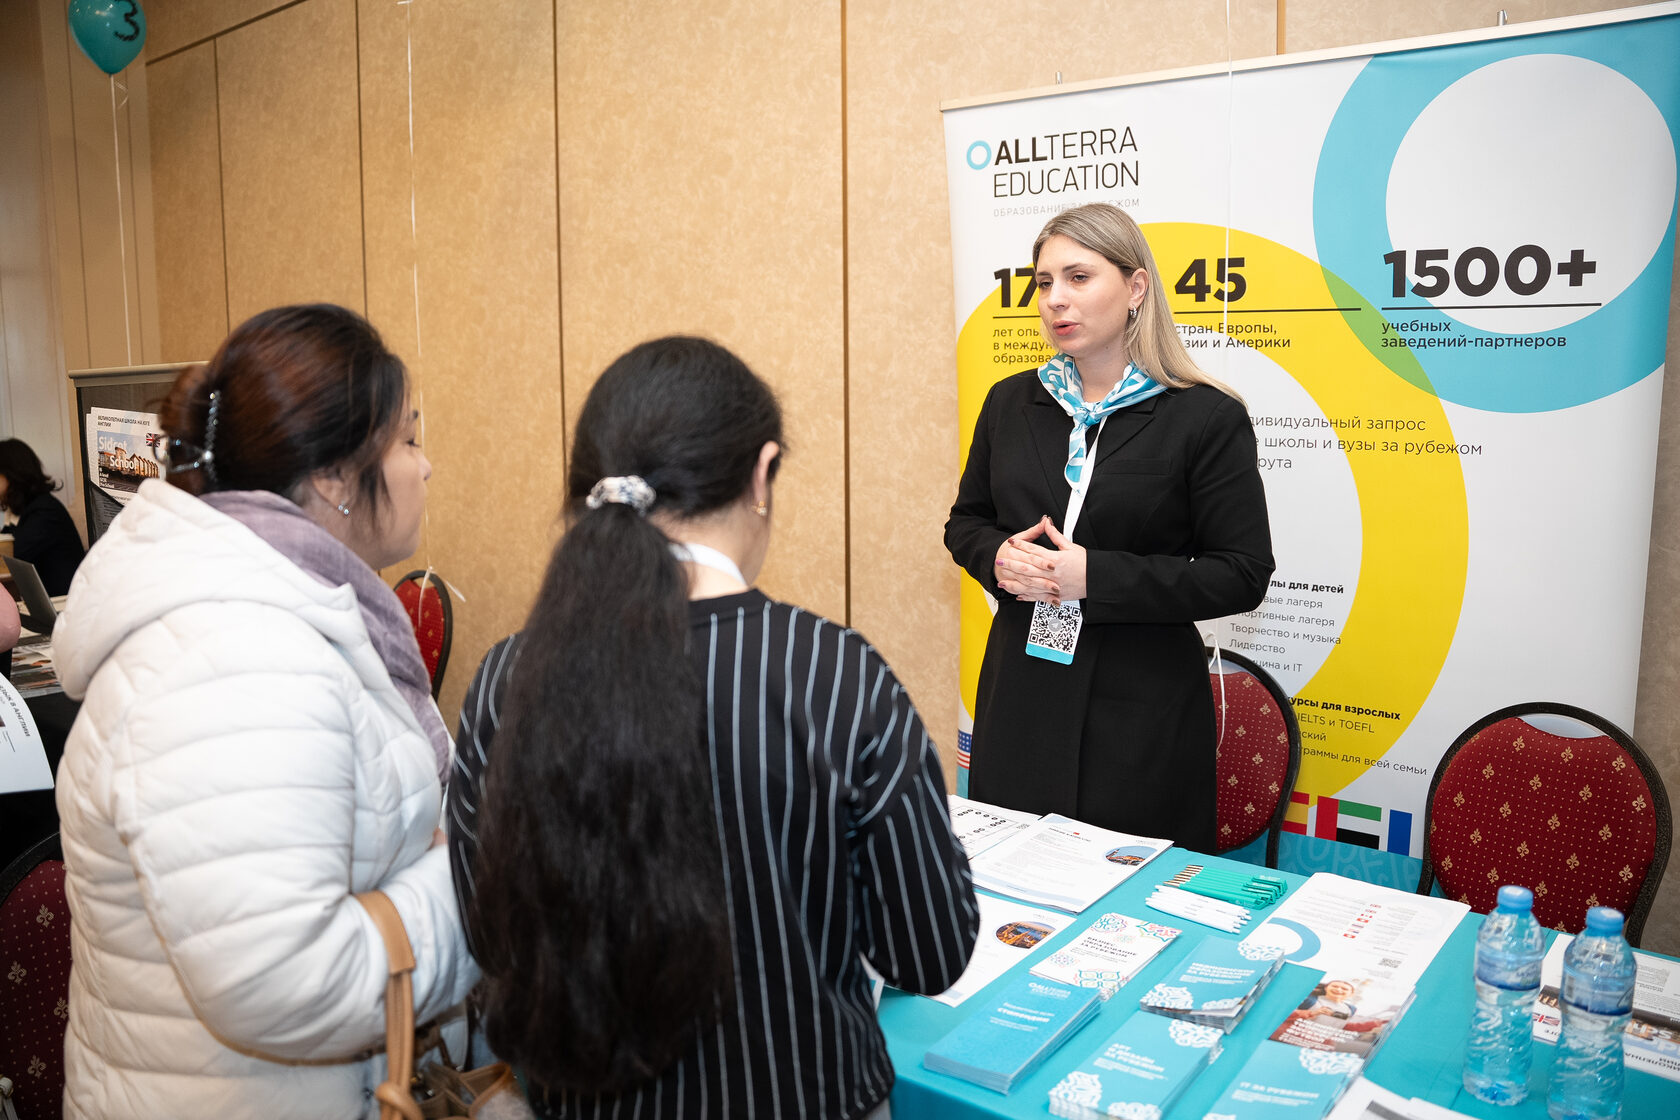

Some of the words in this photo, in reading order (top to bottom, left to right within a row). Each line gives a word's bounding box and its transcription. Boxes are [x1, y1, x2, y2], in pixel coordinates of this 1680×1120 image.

[994, 126, 1138, 166] ALLTERRA
[993, 160, 1140, 198] EDUCATION
[1383, 244, 1597, 298] 1500+
[1174, 257, 1247, 302] 45
[993, 329, 1013, 337] лет
[1218, 322, 1277, 335] Европы,
[1381, 320, 1451, 334] учебных
[993, 342, 1000, 350] в
[1004, 341, 1053, 351] междун
[1184, 339, 1208, 348] зии
[1213, 339, 1221, 348] и
[1226, 337, 1291, 350] Америки
[1381, 334, 1567, 349] заведений-партнеров
[993, 353, 1053, 365] образова
[1249, 416, 1361, 430] дивидуальный
[1366, 418, 1427, 432] запрос
[1264, 437, 1318, 449] школы
[1323, 439, 1332, 449] и
[1338, 440, 1376, 452] вузы
[1382, 441, 1399, 452] за
[1404, 440, 1483, 456] рубежом
[1258, 457, 1292, 469] рута
[1270, 580, 1286, 588] лы
[1288, 582, 1309, 591] для
[1311, 584, 1344, 594] детей
[1263, 596, 1284, 604] вые
[1286, 598, 1323, 609] лагеря
[1234, 610, 1295, 622] портивные
[1298, 615, 1335, 627] лагеря
[1230, 623, 1290, 639] Творчество
[1302, 633, 1342, 645] музыка
[1229, 639, 1286, 654] Лидерство
[1293, 663, 1303, 672] IT
[1321, 701, 1342, 711] для
[1344, 705, 1401, 720] взрослых
[1297, 713, 1326, 725] IELTS
[1339, 719, 1375, 734] TOEFL
[1301, 731, 1327, 742] ский
[1302, 747, 1339, 760] раммы
[1341, 754, 1361, 764] для
[1364, 758, 1390, 769] всей
[1393, 763, 1427, 776] семьи
